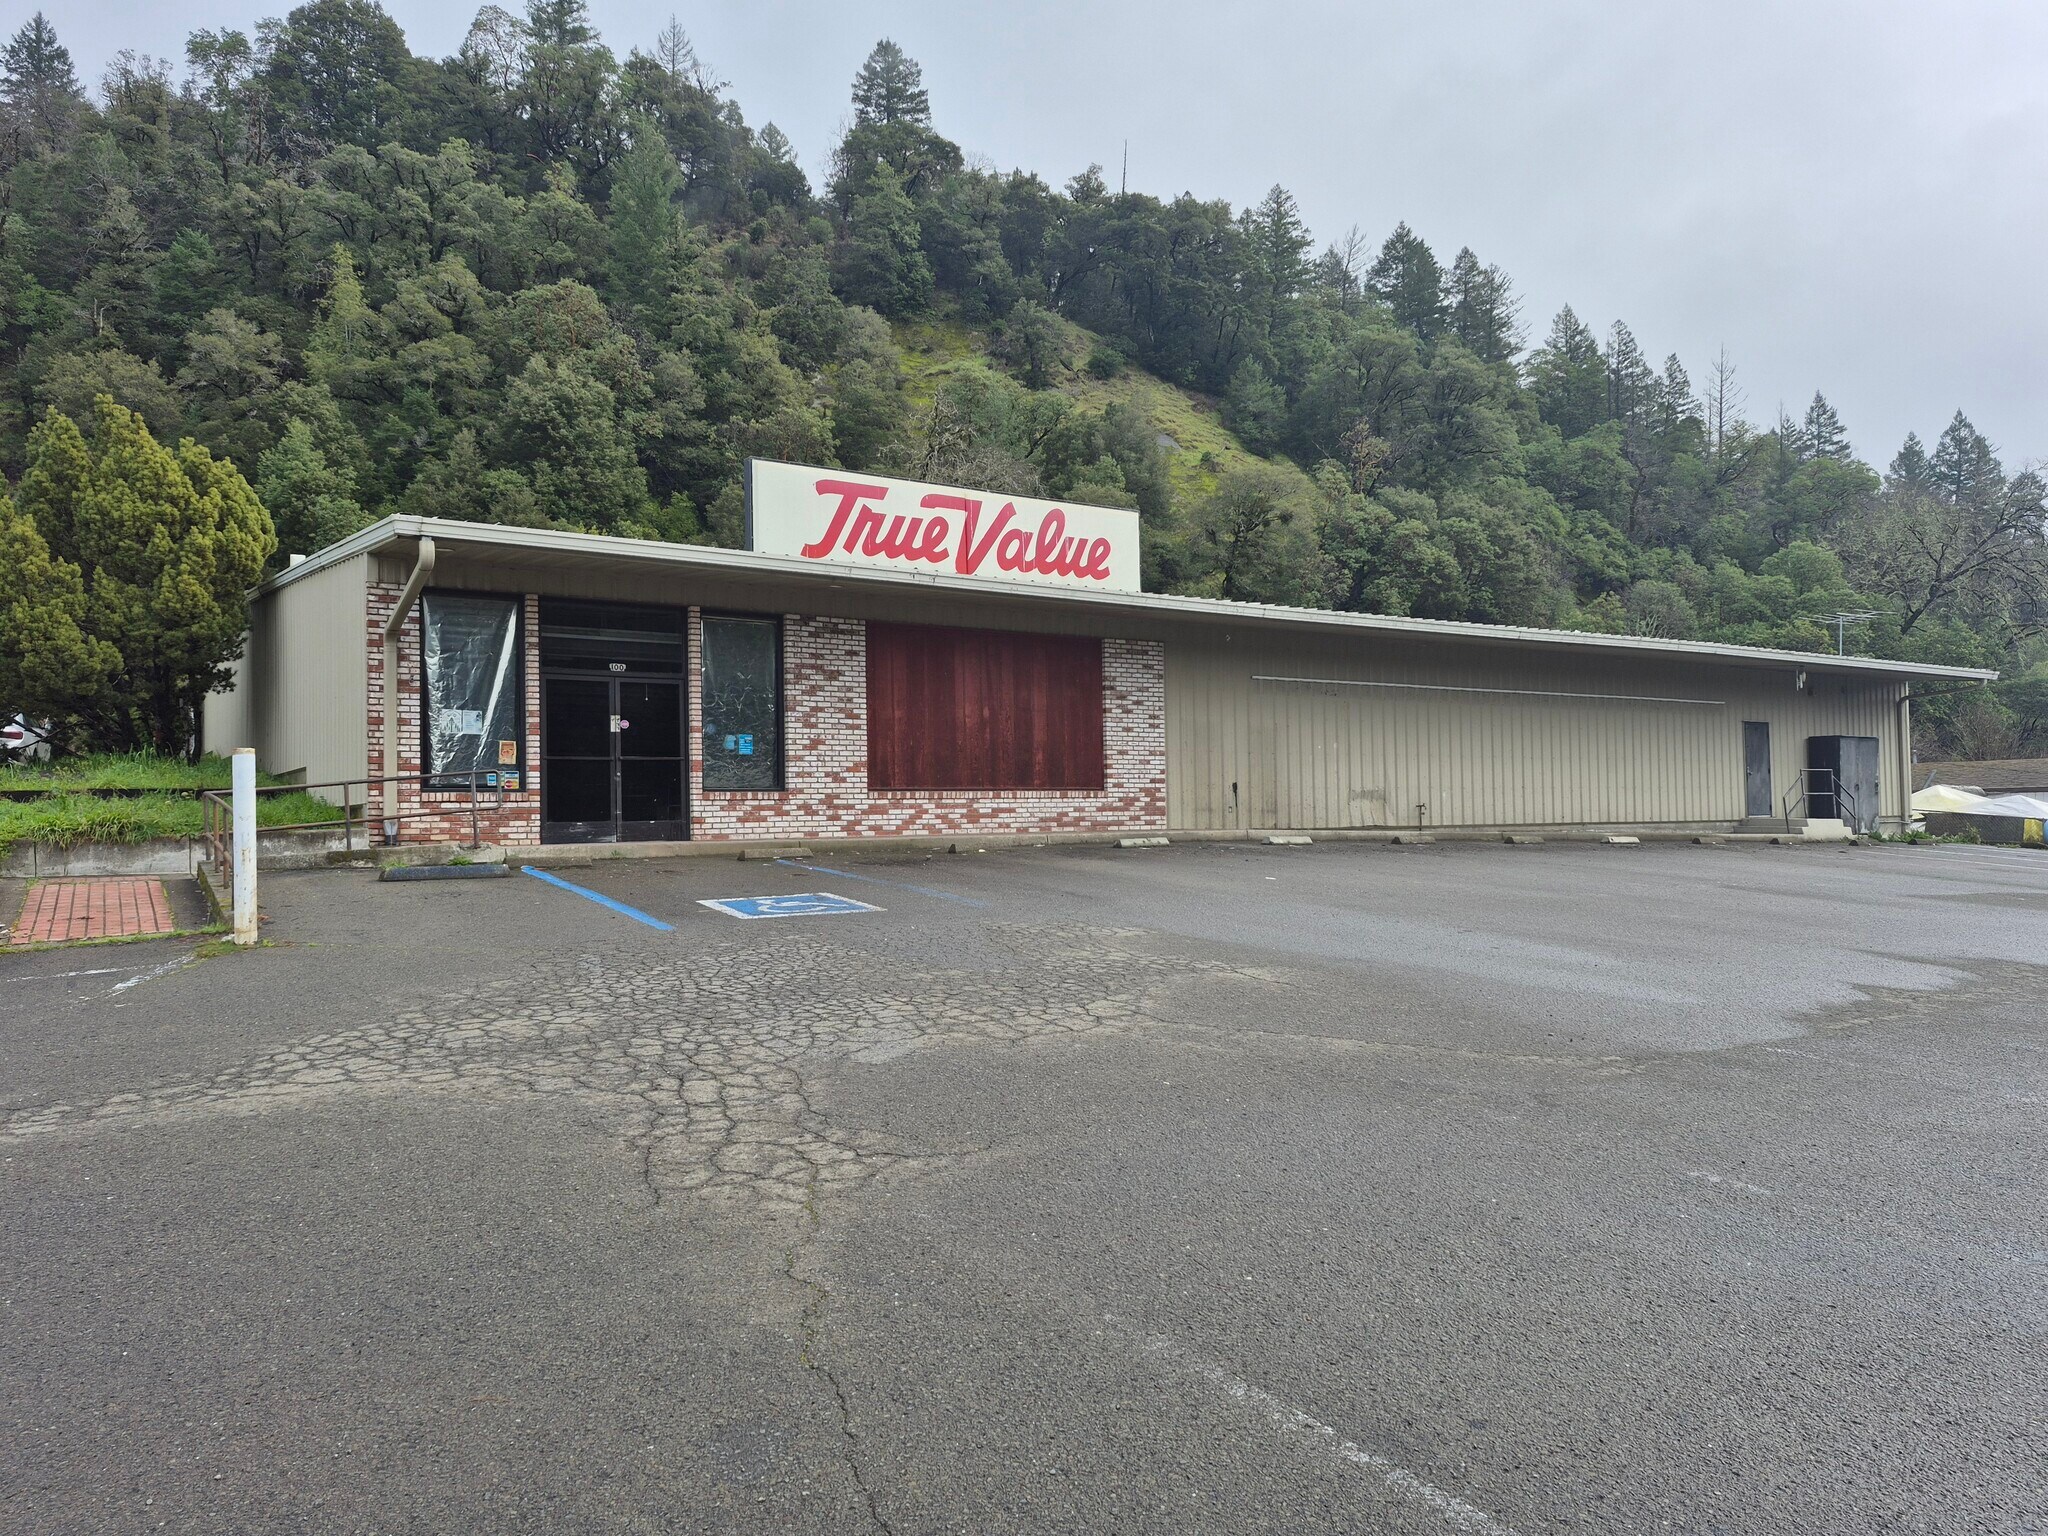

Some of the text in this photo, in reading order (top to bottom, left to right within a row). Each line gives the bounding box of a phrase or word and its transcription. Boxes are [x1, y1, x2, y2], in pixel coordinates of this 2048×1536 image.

[801, 479, 1111, 580] True Value
[610, 663, 625, 671] 100
